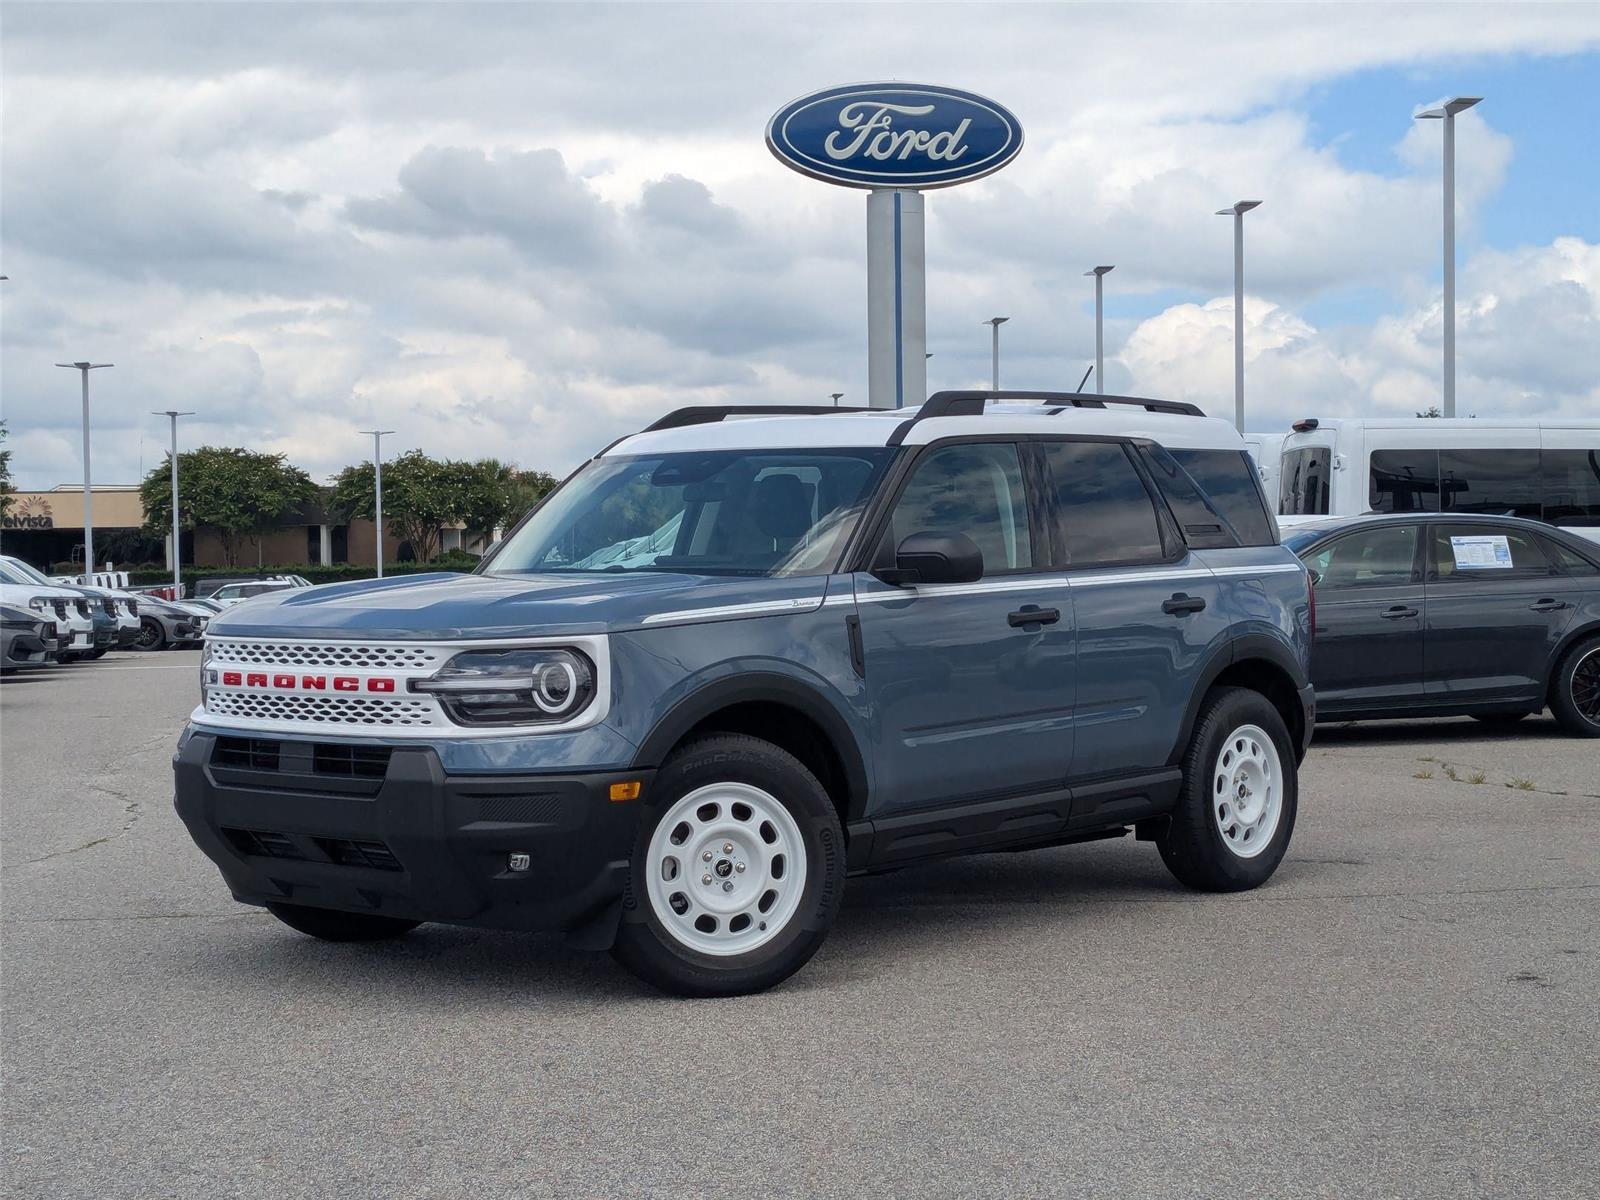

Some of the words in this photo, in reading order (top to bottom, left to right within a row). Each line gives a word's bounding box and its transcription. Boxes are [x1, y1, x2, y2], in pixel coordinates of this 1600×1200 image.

[824, 101, 972, 161] Ford
[1, 513, 53, 529] elvista
[223, 672, 395, 693] BRONCO
